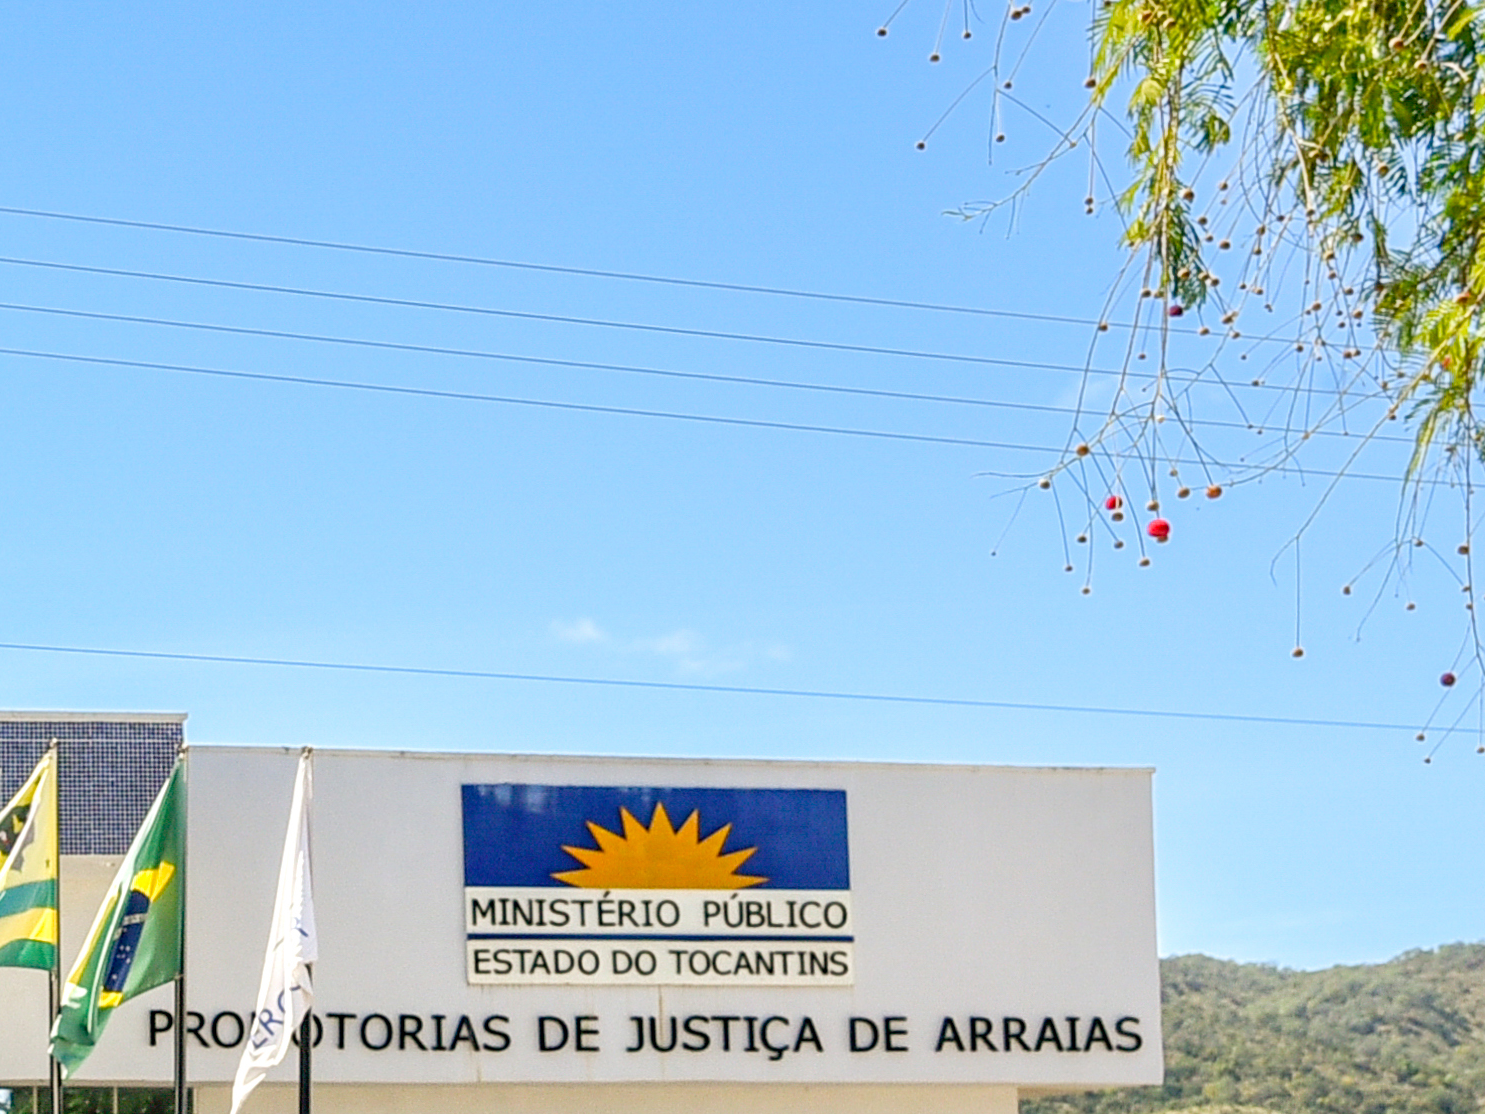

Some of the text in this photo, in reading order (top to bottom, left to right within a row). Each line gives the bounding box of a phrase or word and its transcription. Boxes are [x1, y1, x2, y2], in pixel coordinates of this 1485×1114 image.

[471, 890, 849, 929] MINISTÉRIO PÚBLICO
[473, 949, 850, 976] ESTADO DO TOCANTINS
[148, 1010, 511, 1052] PROOTORIAS
[537, 1015, 600, 1052] DE
[626, 1016, 824, 1062] JUSTIÇA
[849, 1017, 909, 1052] DE
[935, 1016, 1143, 1053] ARRAIAS
